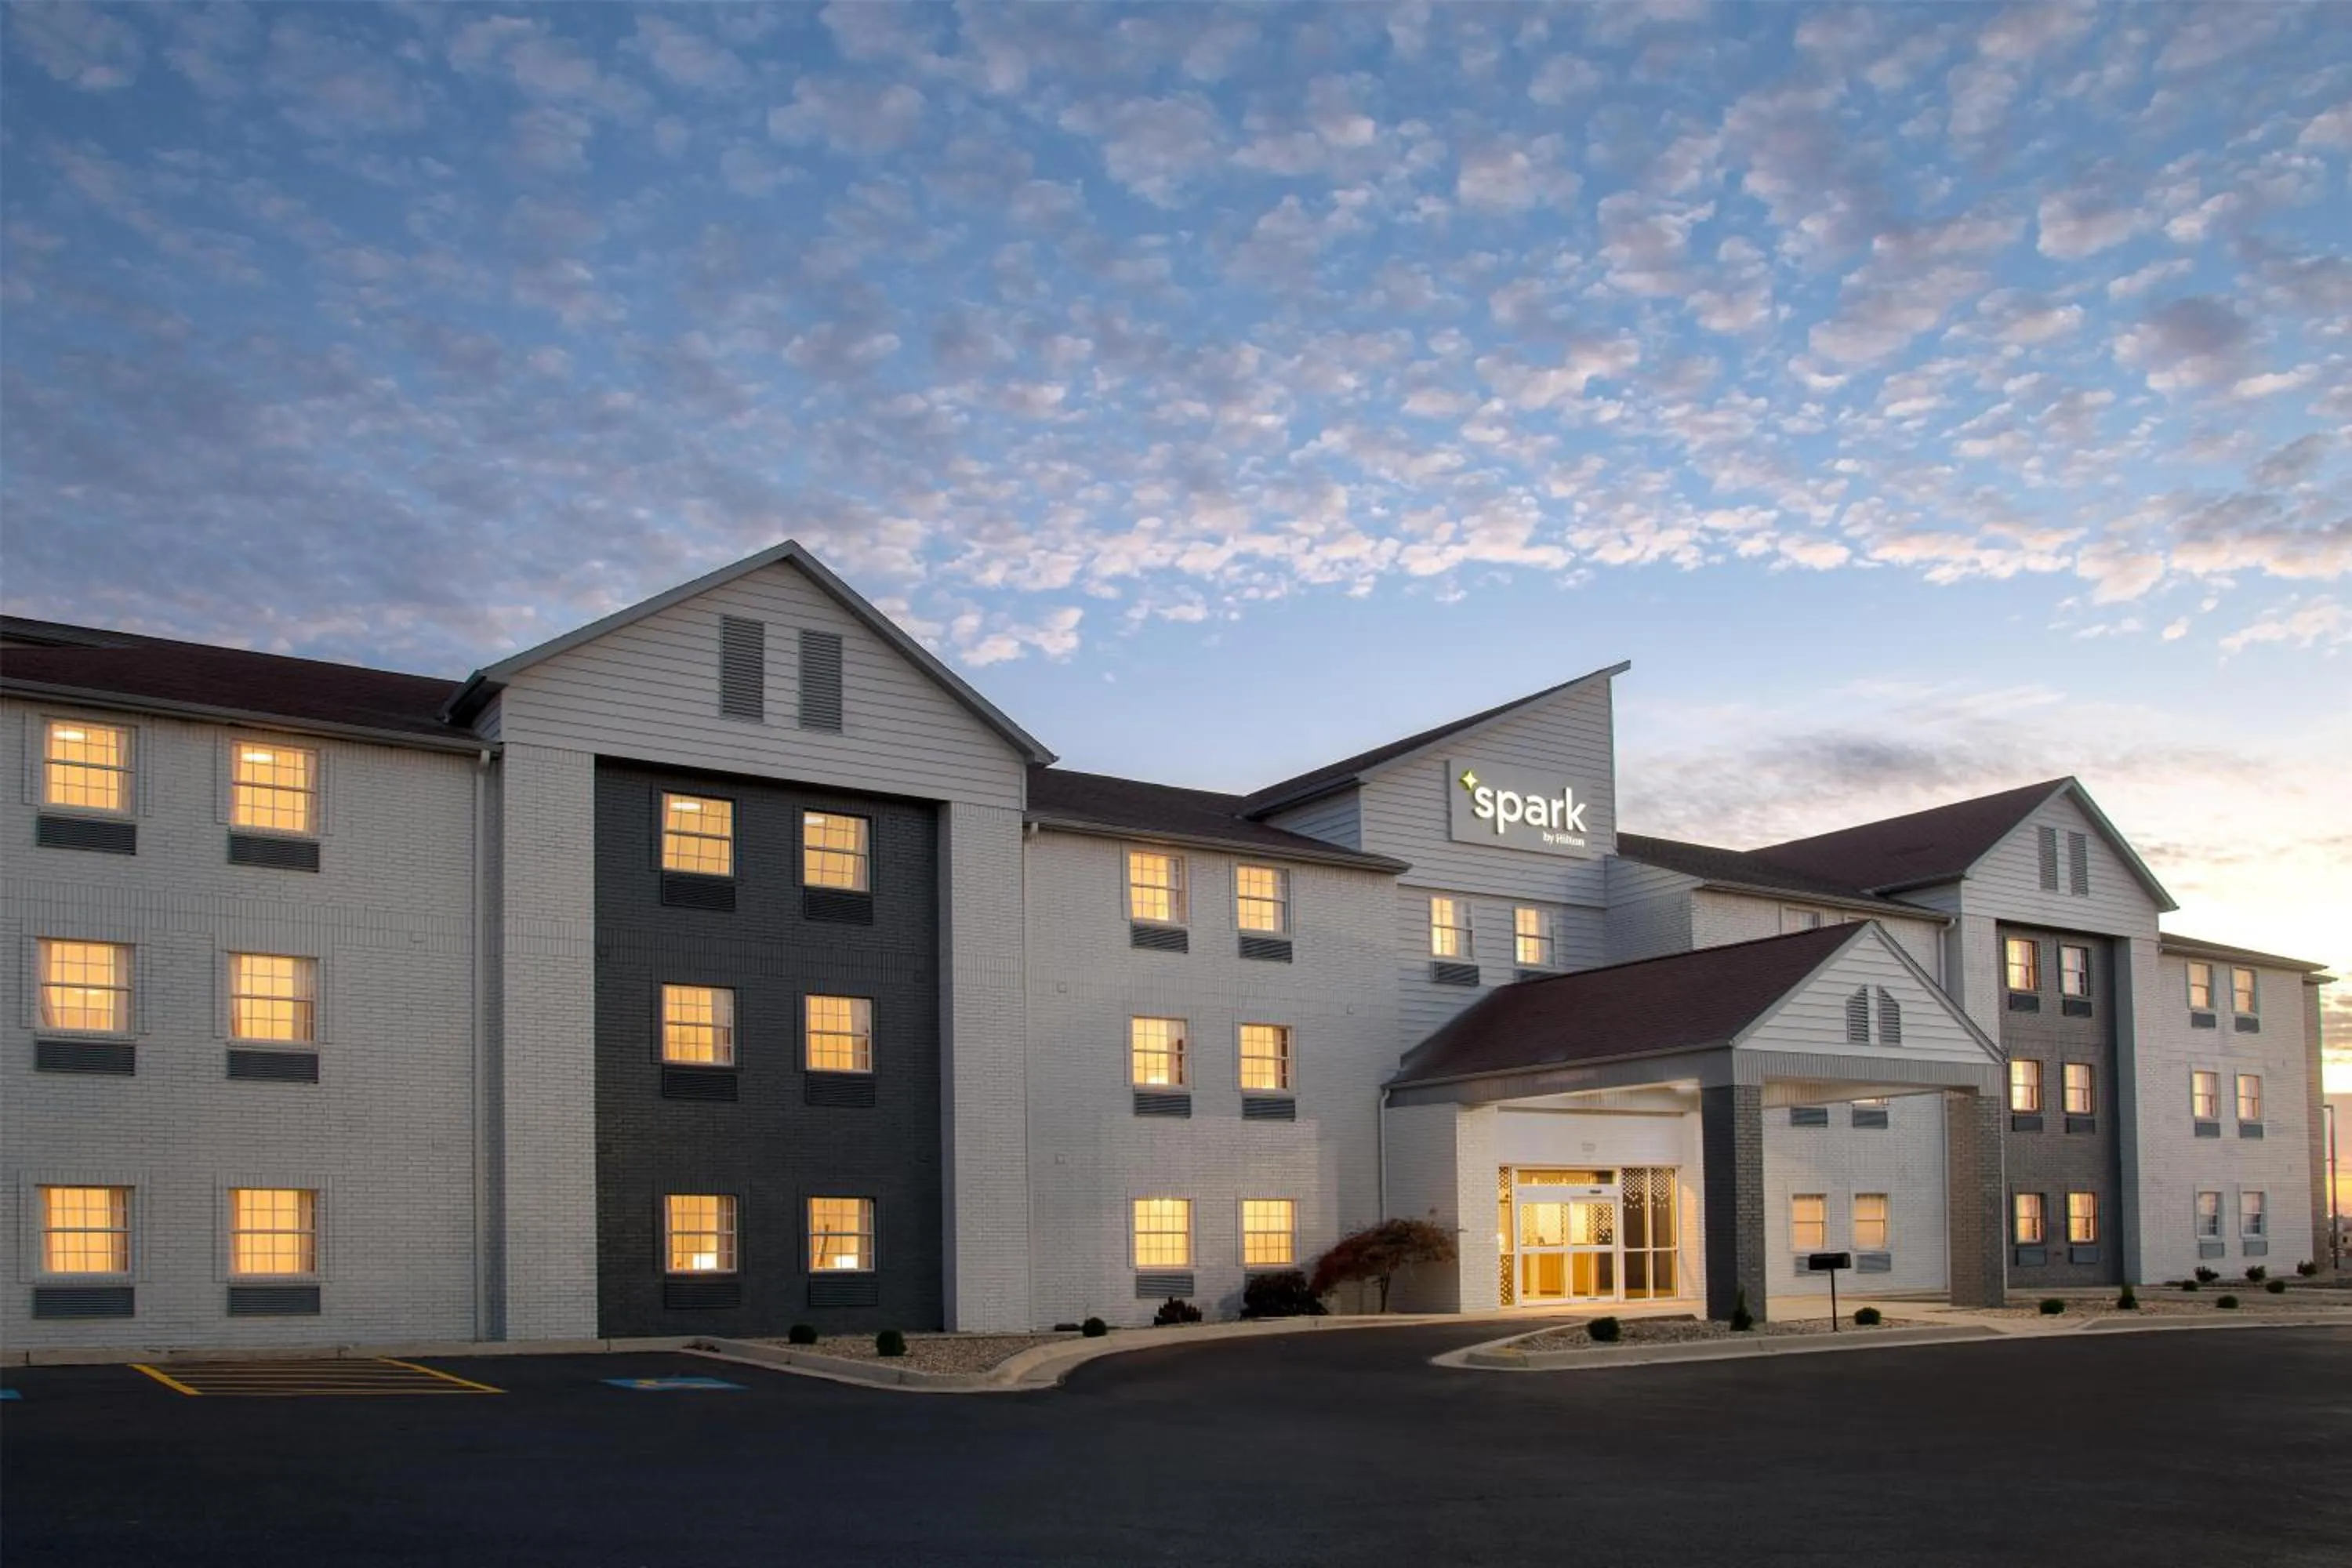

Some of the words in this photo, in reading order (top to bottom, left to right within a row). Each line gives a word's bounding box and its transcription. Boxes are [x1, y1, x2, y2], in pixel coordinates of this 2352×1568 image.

[1474, 786, 1587, 834] spark
[1543, 831, 1554, 847] by
[1555, 833, 1584, 848] Hilton
